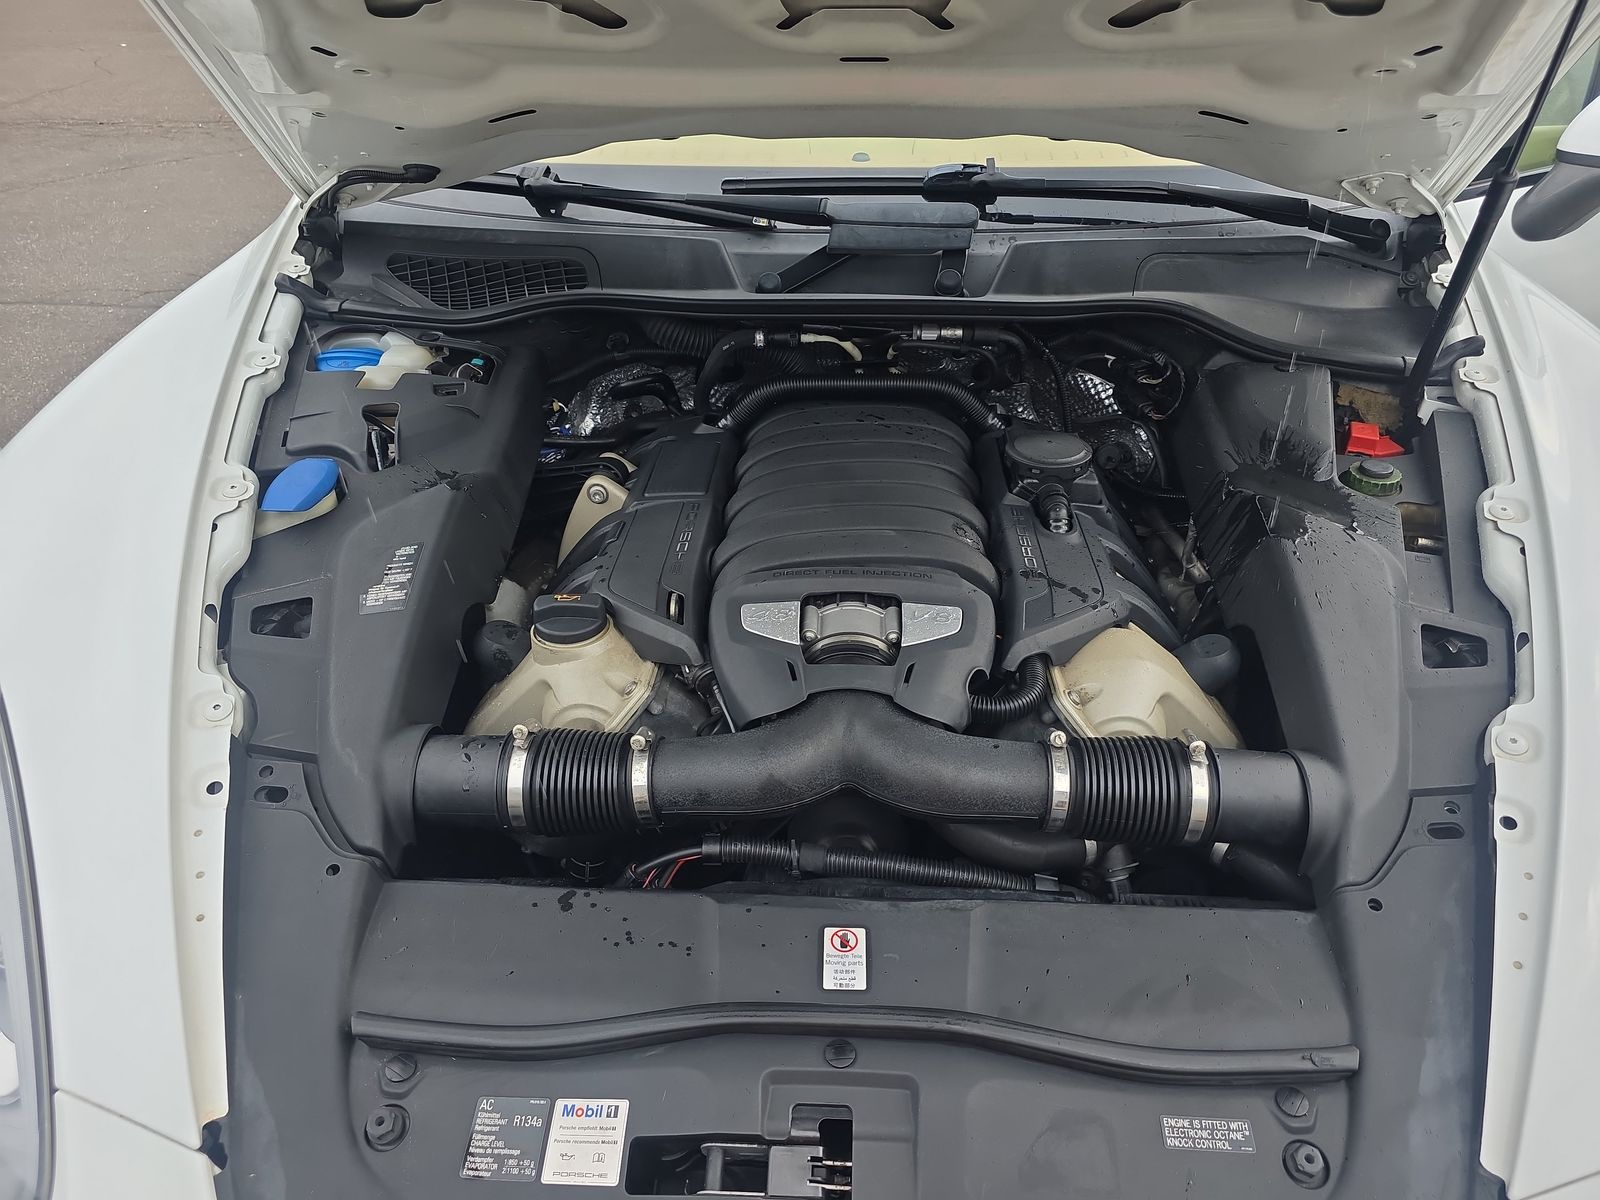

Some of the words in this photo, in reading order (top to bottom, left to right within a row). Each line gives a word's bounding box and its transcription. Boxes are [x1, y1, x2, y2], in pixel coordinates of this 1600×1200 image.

[773, 570, 819, 578] DIRECT
[862, 569, 932, 580] INJECTION
[479, 1099, 495, 1110] AC
[561, 1104, 604, 1118] Mobil
[513, 1115, 543, 1127] R134a
[1163, 1118, 1192, 1128] ENGINE
[1193, 1120, 1201, 1129] IS
[1202, 1120, 1228, 1130] FITTED
[1229, 1121, 1249, 1131] WITH
[1165, 1127, 1213, 1139] ELECTRONIC
[1166, 1137, 1194, 1148] KNOCK
[1195, 1138, 1233, 1150] CONTROL
[552, 1171, 609, 1179] PORSCHE
